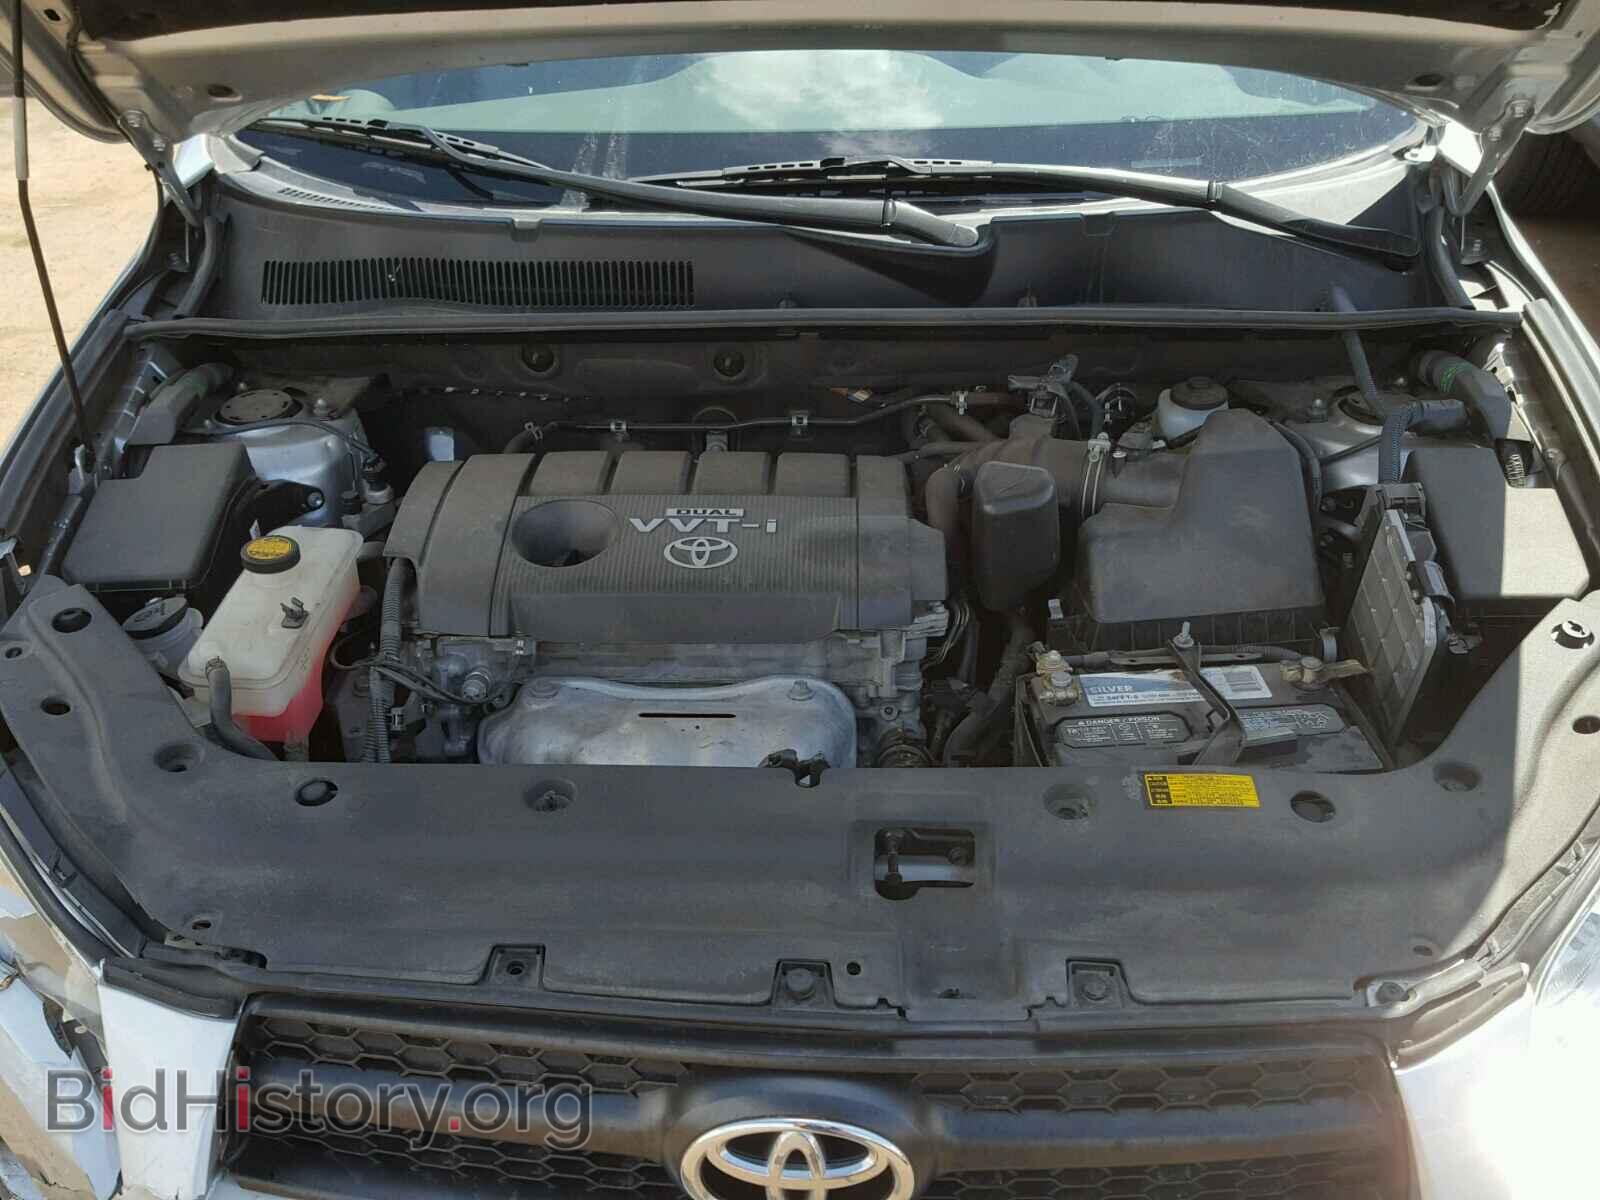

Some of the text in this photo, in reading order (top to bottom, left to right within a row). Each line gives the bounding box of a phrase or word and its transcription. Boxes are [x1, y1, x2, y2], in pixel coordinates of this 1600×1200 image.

[676, 508, 738, 516] DUAL
[629, 517, 777, 533] VVT-i
[1089, 685, 1134, 694] SILVER
[1086, 718, 1120, 726] DANGER
